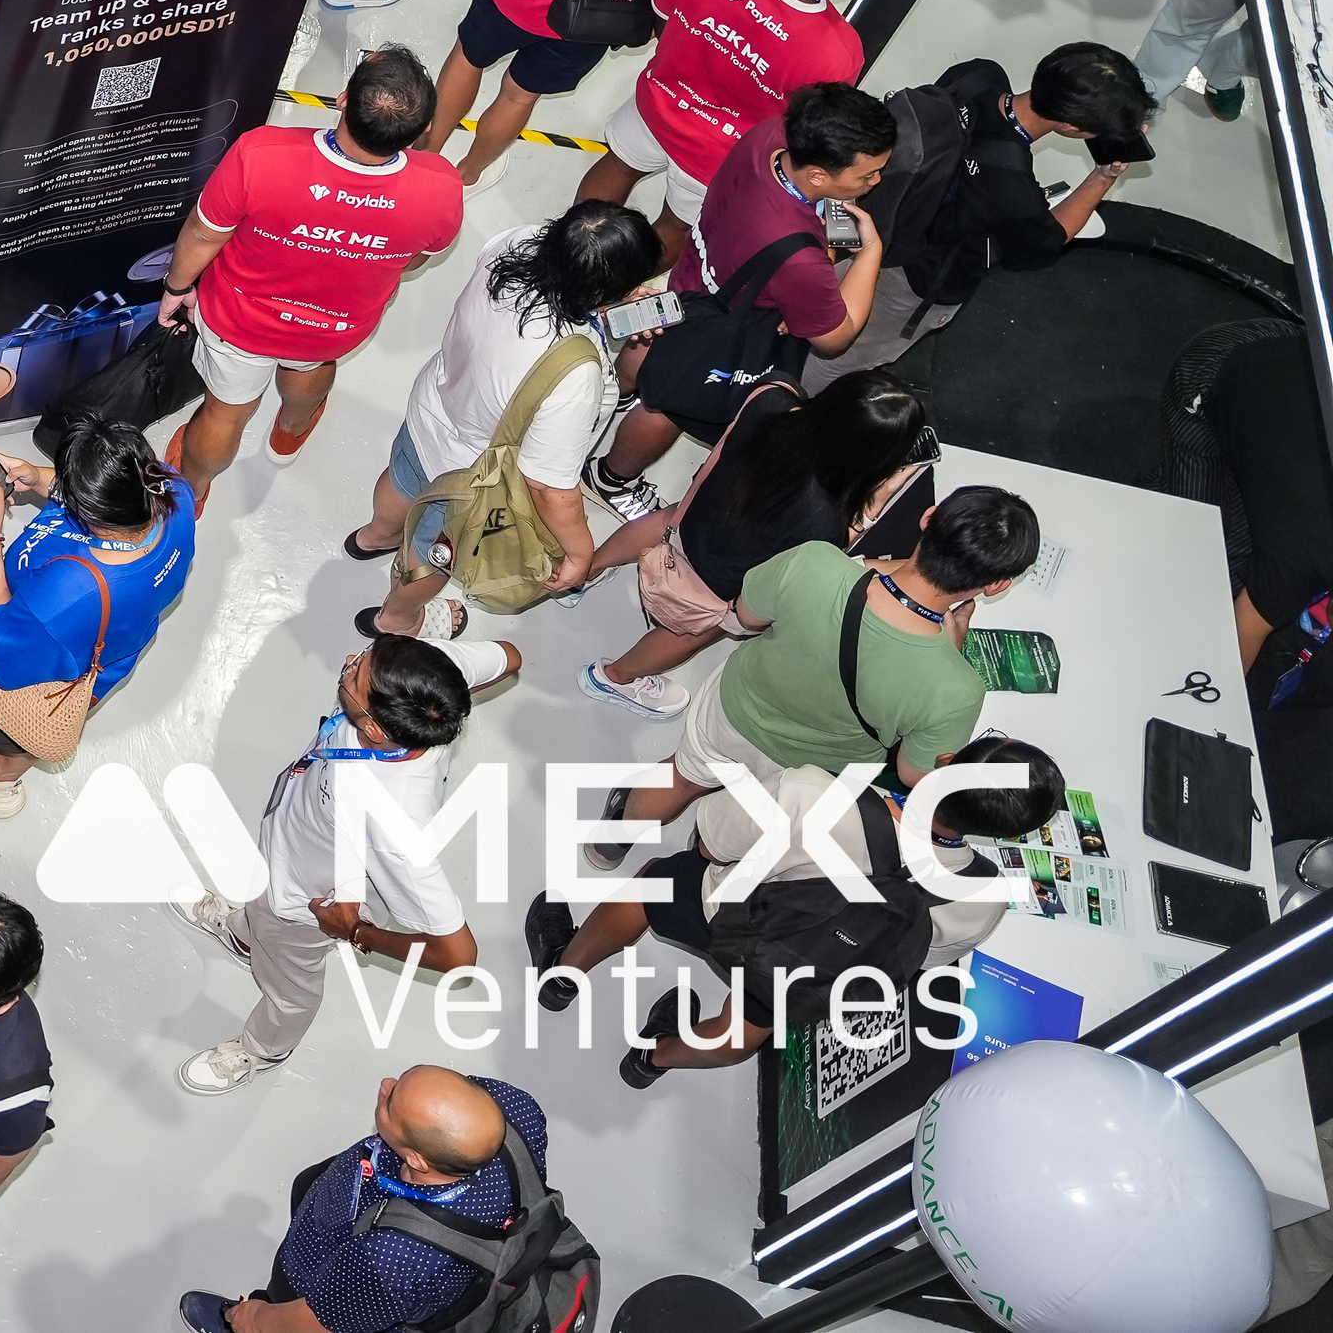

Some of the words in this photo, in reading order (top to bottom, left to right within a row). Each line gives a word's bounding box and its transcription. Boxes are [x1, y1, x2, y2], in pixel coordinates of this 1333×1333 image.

[30, 9, 91, 33] Team
[60, 18, 124, 44] ranks
[133, 12, 154, 27] to
[744, 0, 790, 42] Paylabs
[44, 11, 237, 67] 1,050,000USDT!
[699, 15, 747, 49] ASK
[740, 45, 771, 76] ME
[336, 190, 395, 210] Paylabs
[253, 226, 280, 241] How
[282, 237, 295, 247] to
[298, 242, 332, 254] Grow
[334, 247, 362, 260] Your
[364, 251, 413, 261] Revenue
[291, 224, 345, 243] ASK
[348, 232, 389, 249] ME
[271, 296, 349, 318] www.paylabs.co.id
[70, 532, 93, 544] MEXC
[921, 1098, 1014, 1322] ADVANCE.AI
